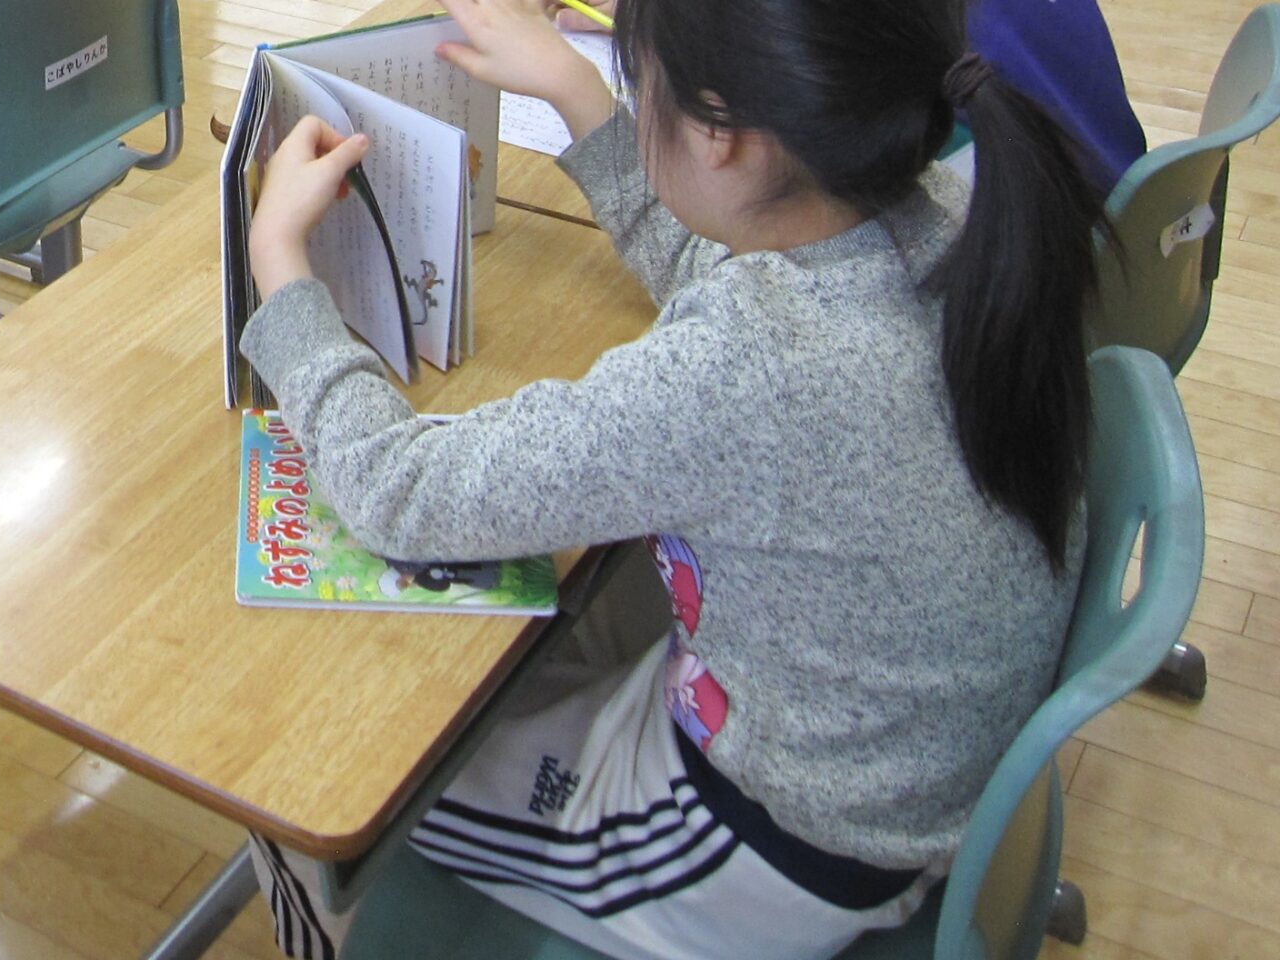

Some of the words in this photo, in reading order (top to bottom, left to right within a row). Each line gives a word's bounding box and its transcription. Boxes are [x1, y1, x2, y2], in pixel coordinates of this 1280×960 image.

[47, 57, 83, 83] こばやし
[260, 421, 314, 589] ねずみのよめいり
